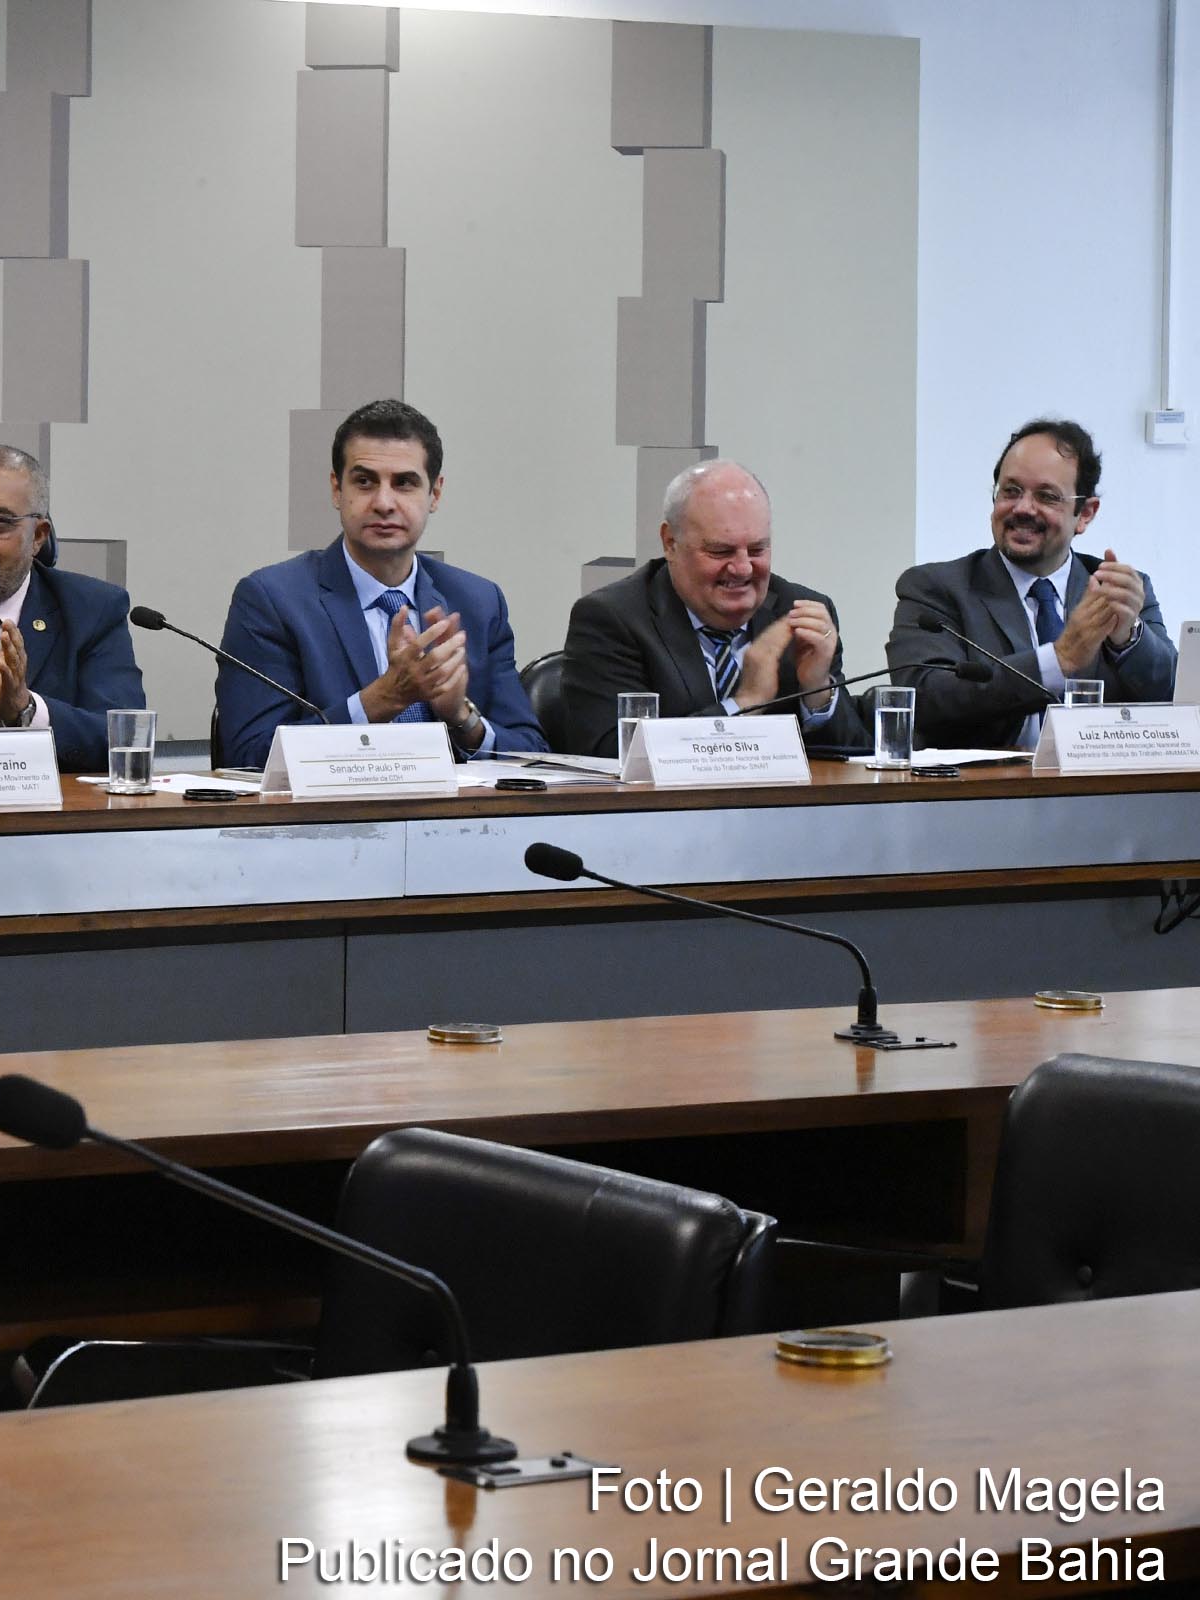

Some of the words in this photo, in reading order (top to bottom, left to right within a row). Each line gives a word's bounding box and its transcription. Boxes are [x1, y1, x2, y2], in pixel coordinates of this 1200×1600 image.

[1079, 730, 1101, 741] Luiz
[1103, 729, 1141, 740] Antônio
[1142, 729, 1180, 740] Colussi
[692, 742, 732, 755] Rogério
[734, 742, 760, 752] Silva
[329, 764, 365, 774] Senador
[368, 763, 392, 773] Paulo
[394, 762, 417, 771] Paim
[348, 775, 379, 783] Presidente
